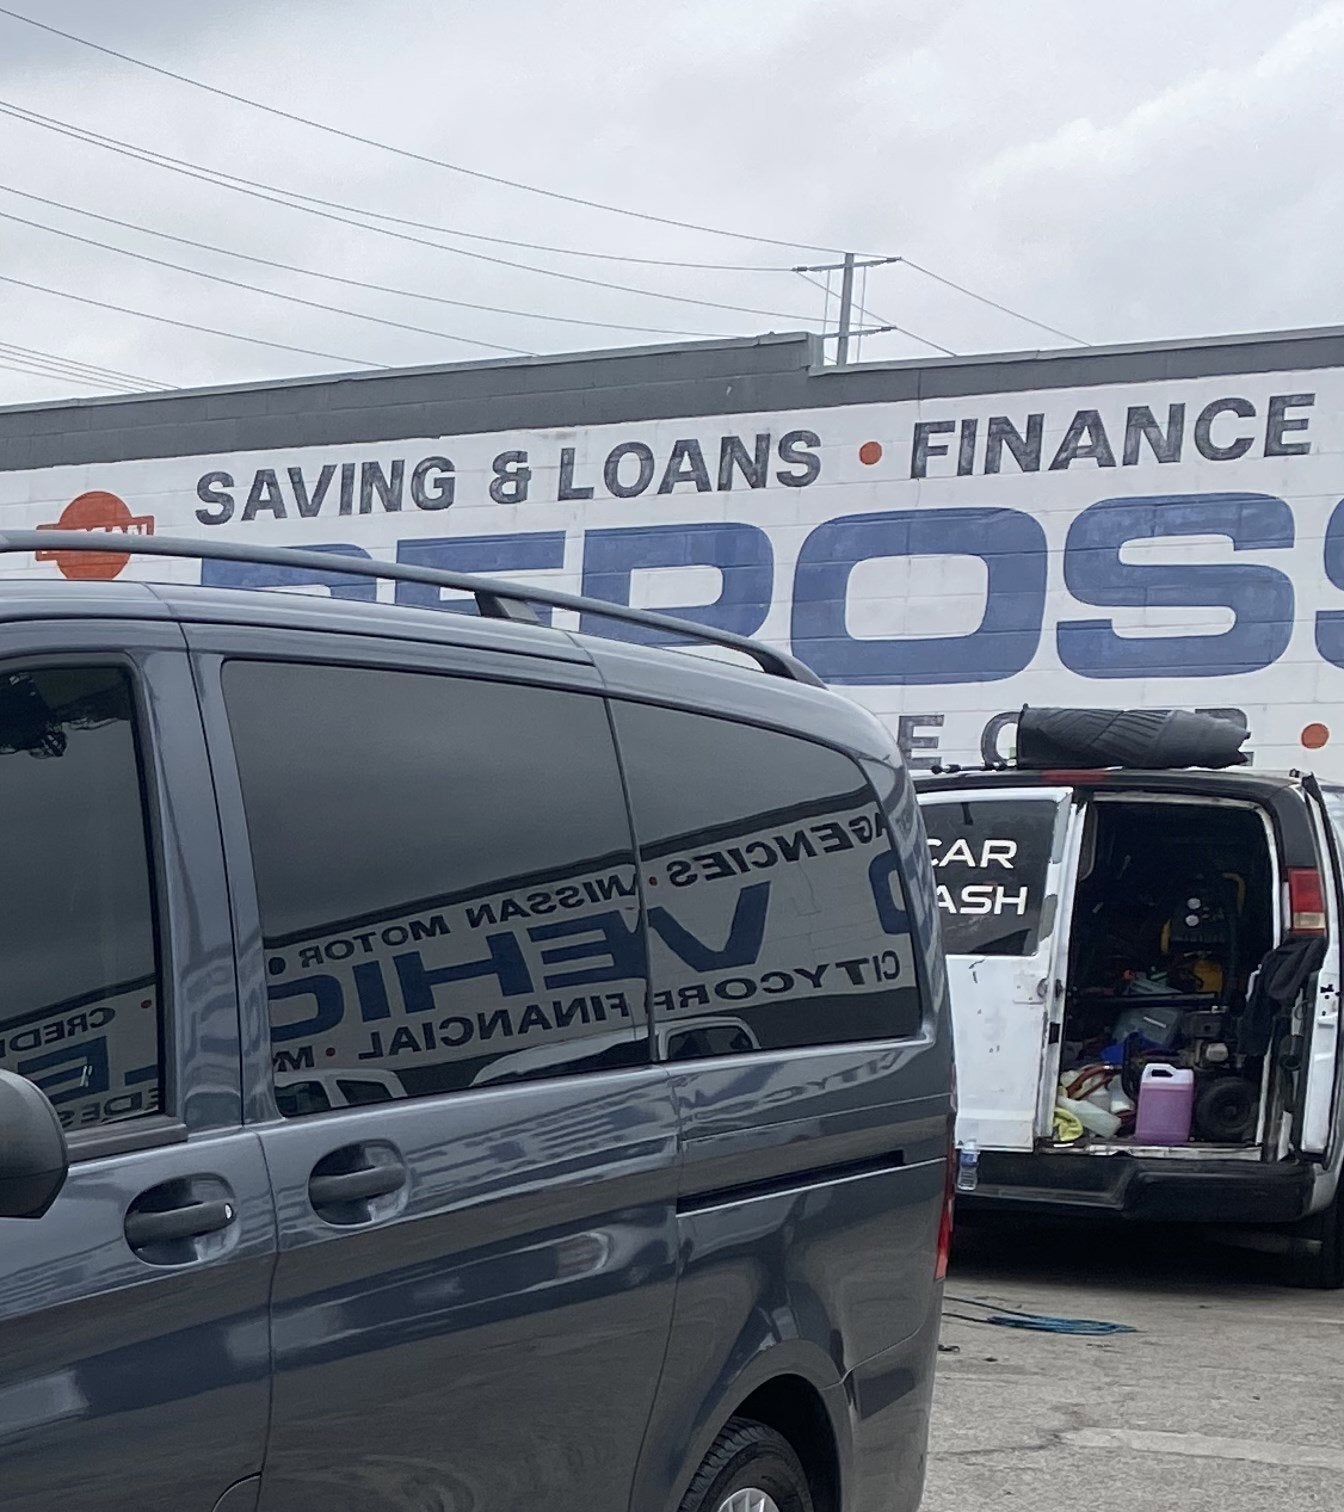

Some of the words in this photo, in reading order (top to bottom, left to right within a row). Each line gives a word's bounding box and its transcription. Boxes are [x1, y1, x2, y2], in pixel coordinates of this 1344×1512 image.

[196, 456, 456, 526] SAVING
[490, 450, 532, 504] &
[556, 430, 822, 501] LOANS
[910, 394, 1316, 479] FINANCE
[936, 884, 1028, 916] ASH
